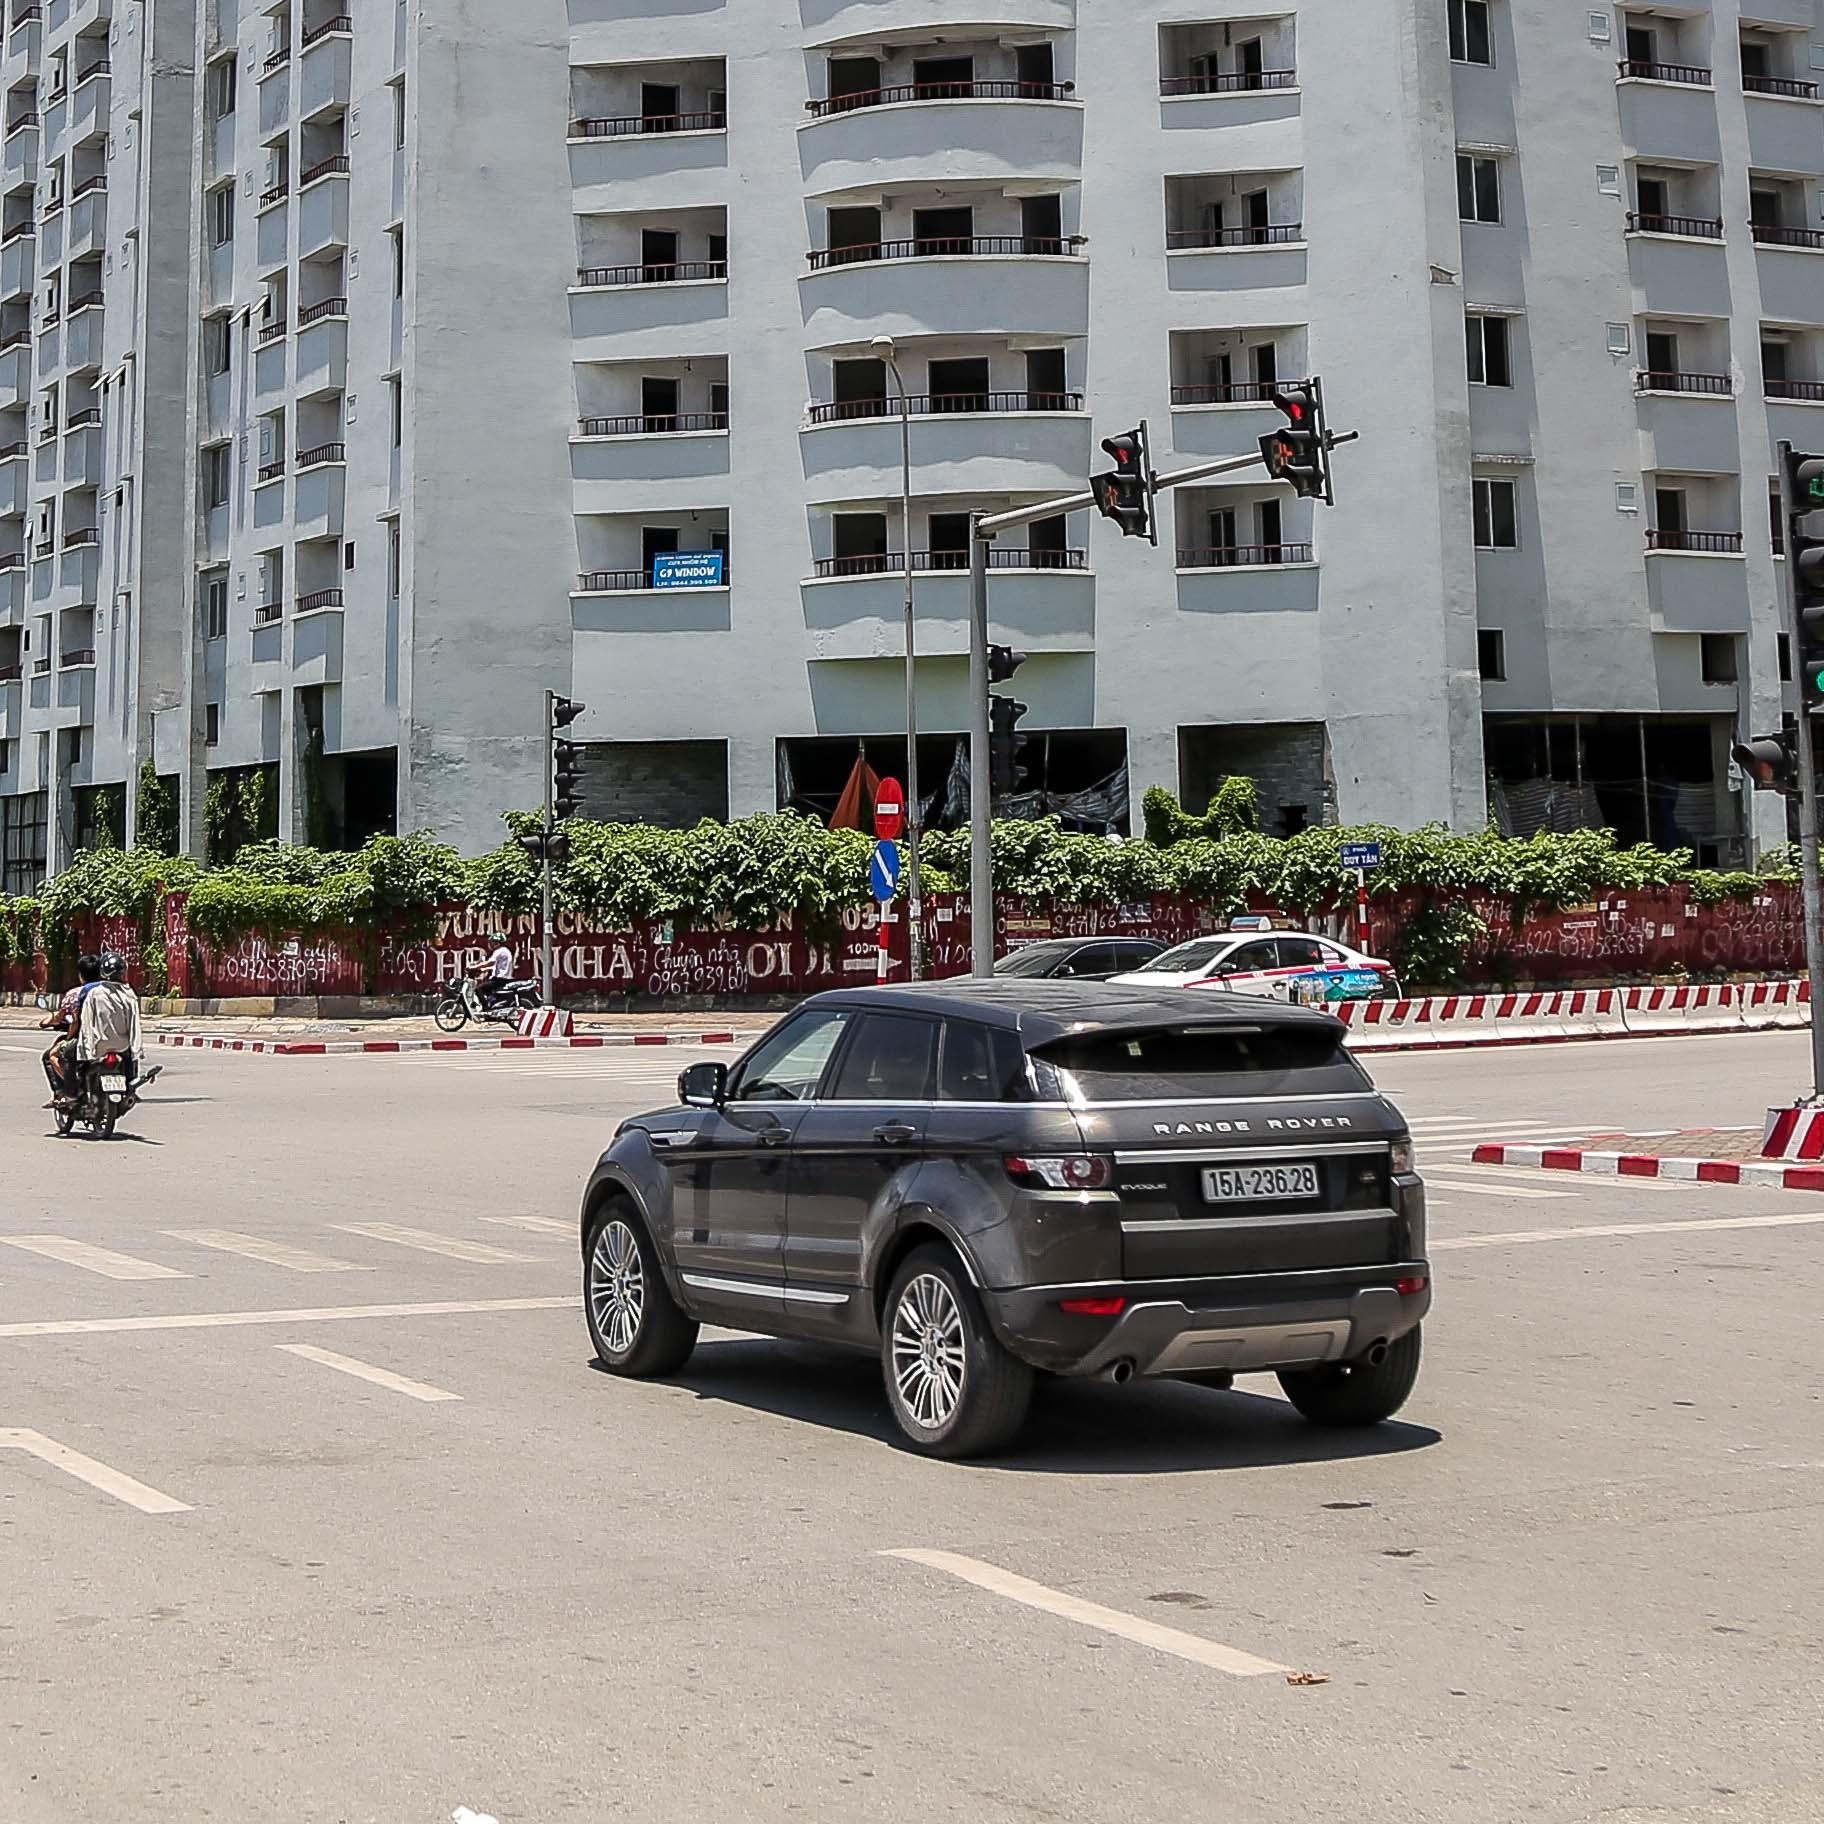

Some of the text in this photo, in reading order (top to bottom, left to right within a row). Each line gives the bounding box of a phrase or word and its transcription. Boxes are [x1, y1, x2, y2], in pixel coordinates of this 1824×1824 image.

[675, 566, 716, 578] WINDOW
[1153, 1116, 1353, 1136] RANGE ROVER
[1120, 1183, 1168, 1191] EVOQUE
[1208, 1167, 1316, 1199] 15A-236.28
